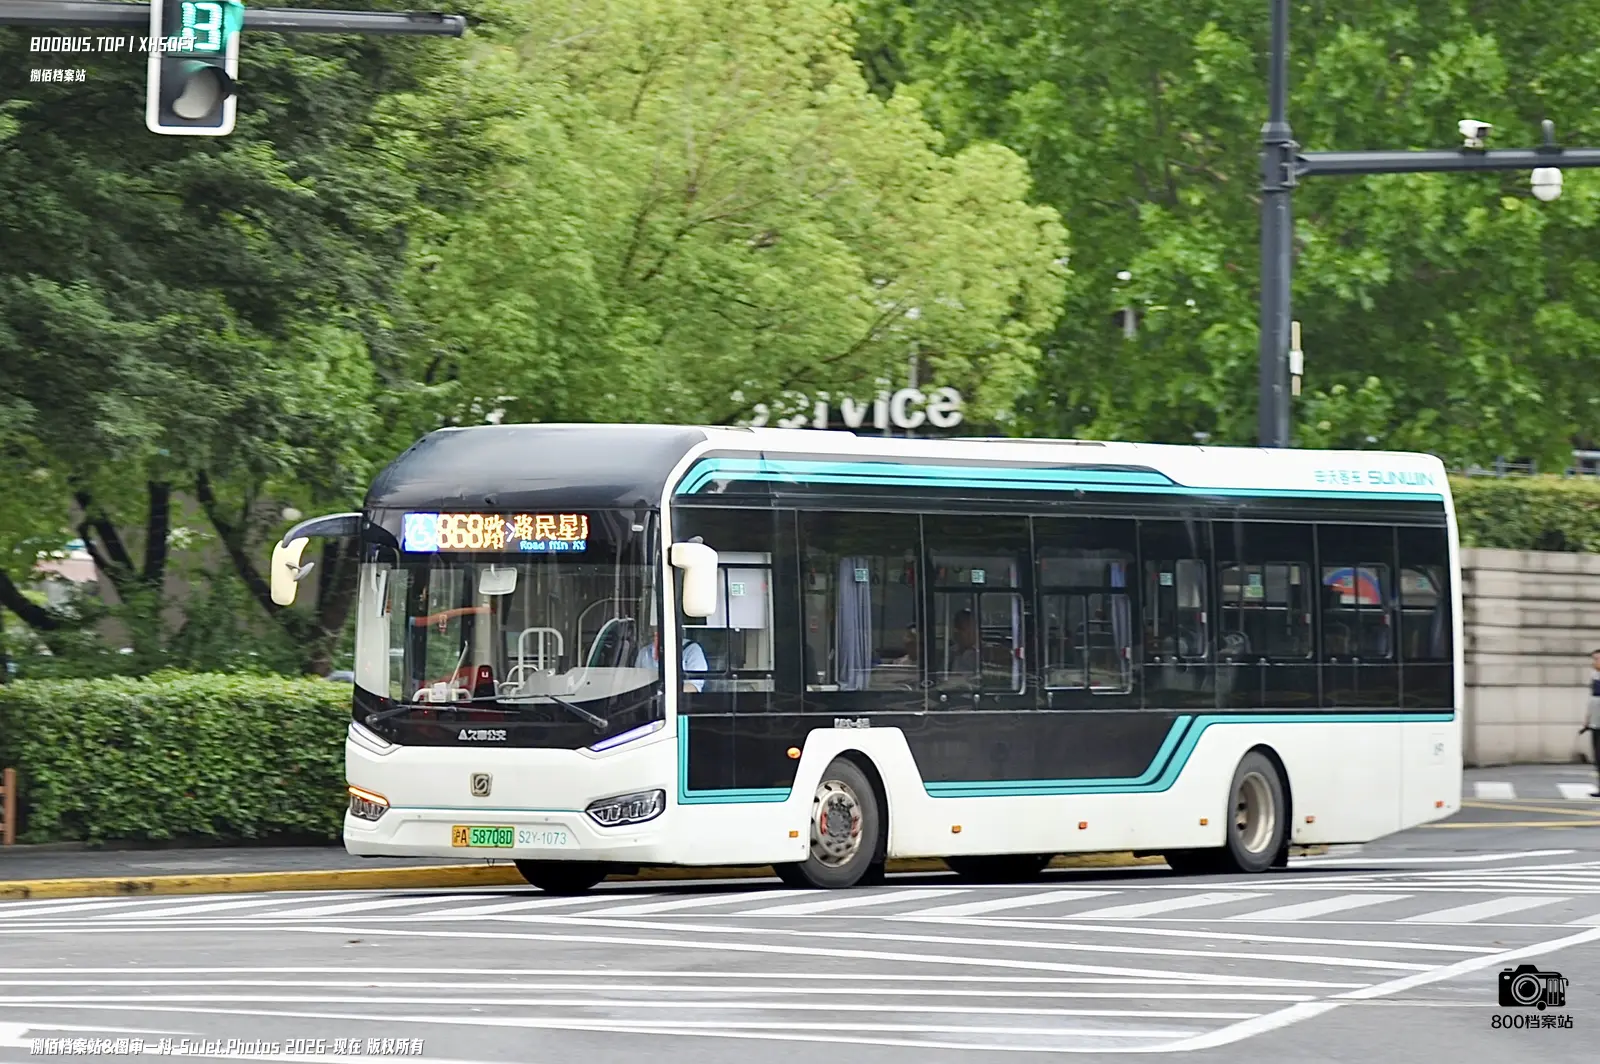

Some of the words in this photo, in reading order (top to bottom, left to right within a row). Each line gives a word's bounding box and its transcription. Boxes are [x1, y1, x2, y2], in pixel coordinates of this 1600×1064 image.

[437, 514, 505, 549] 868路
[514, 514, 588, 541] 路民星
[518, 829, 567, 846] S2Y-1073
